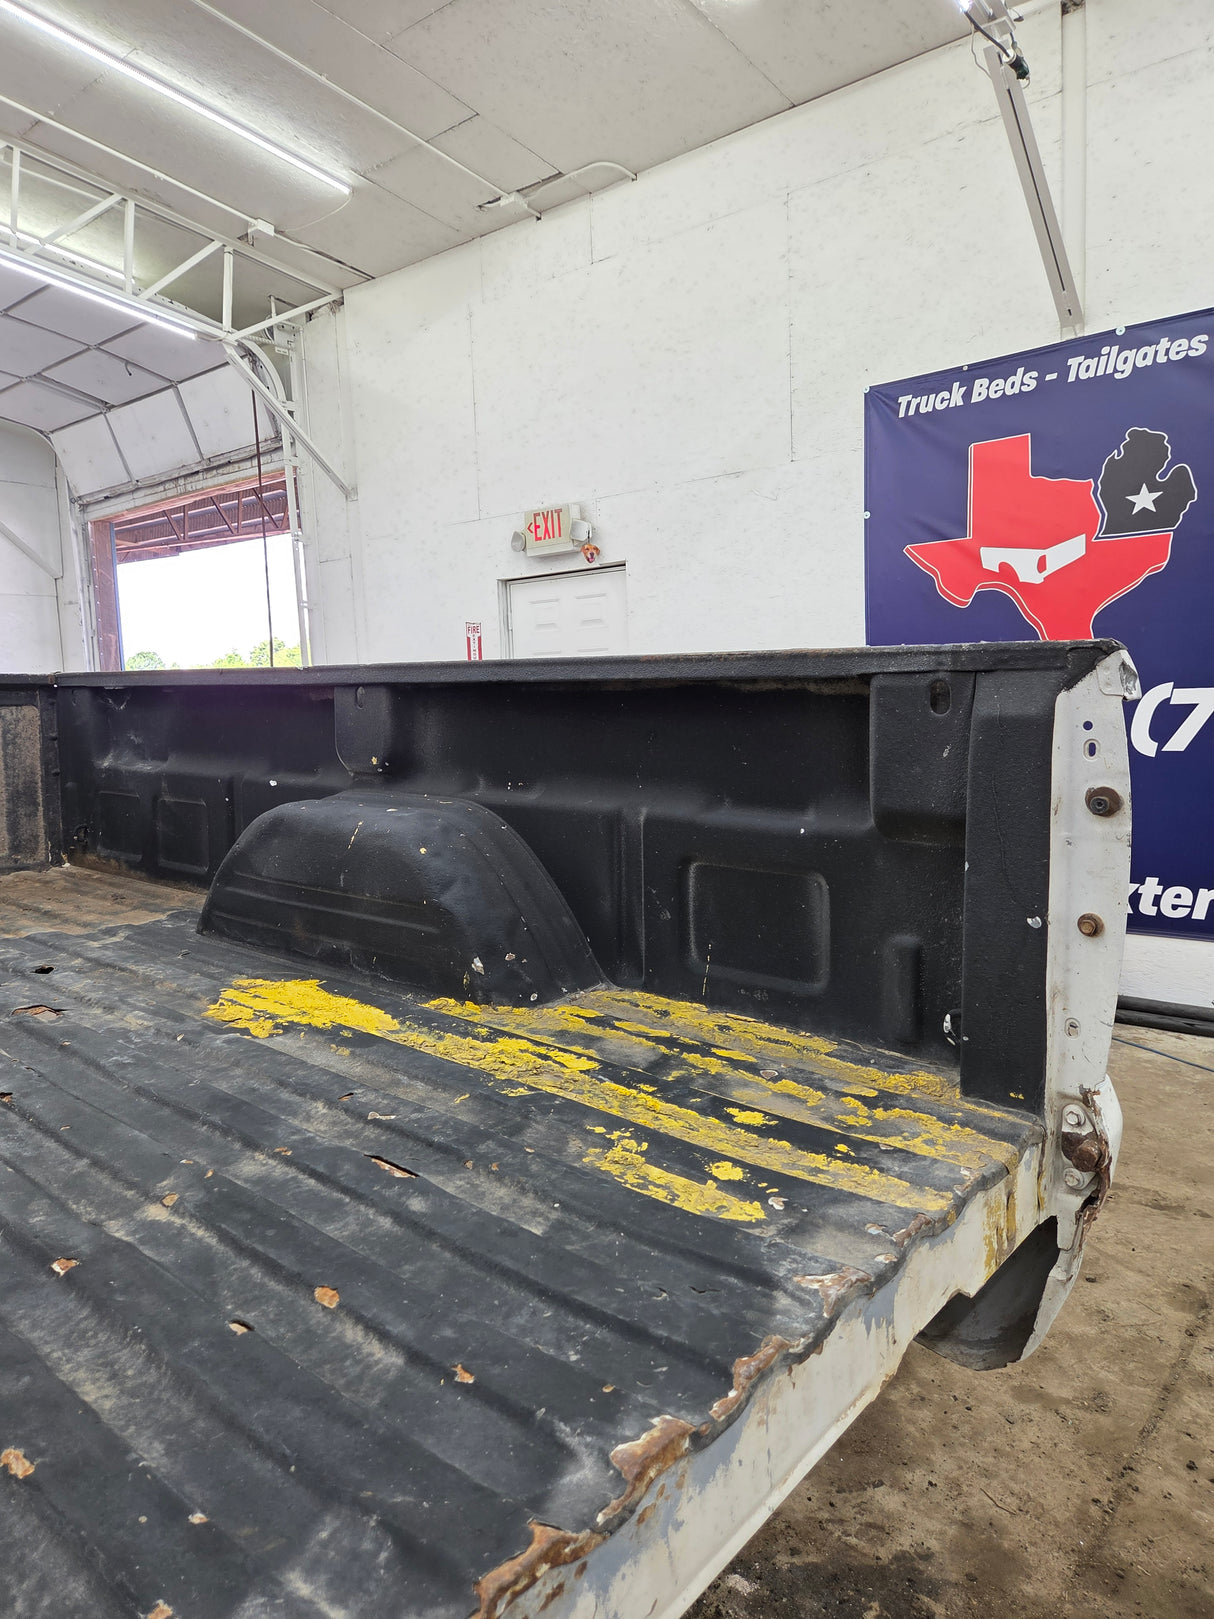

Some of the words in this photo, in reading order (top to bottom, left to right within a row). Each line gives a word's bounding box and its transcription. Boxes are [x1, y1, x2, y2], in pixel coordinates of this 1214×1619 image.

[898, 381, 967, 418] Truck
[970, 367, 1039, 404] Beds
[1045, 372, 1058, 381] -
[1067, 334, 1209, 383] Tailgates
[533, 508, 562, 541] EXIT
[467, 625, 480, 635] FIRE
